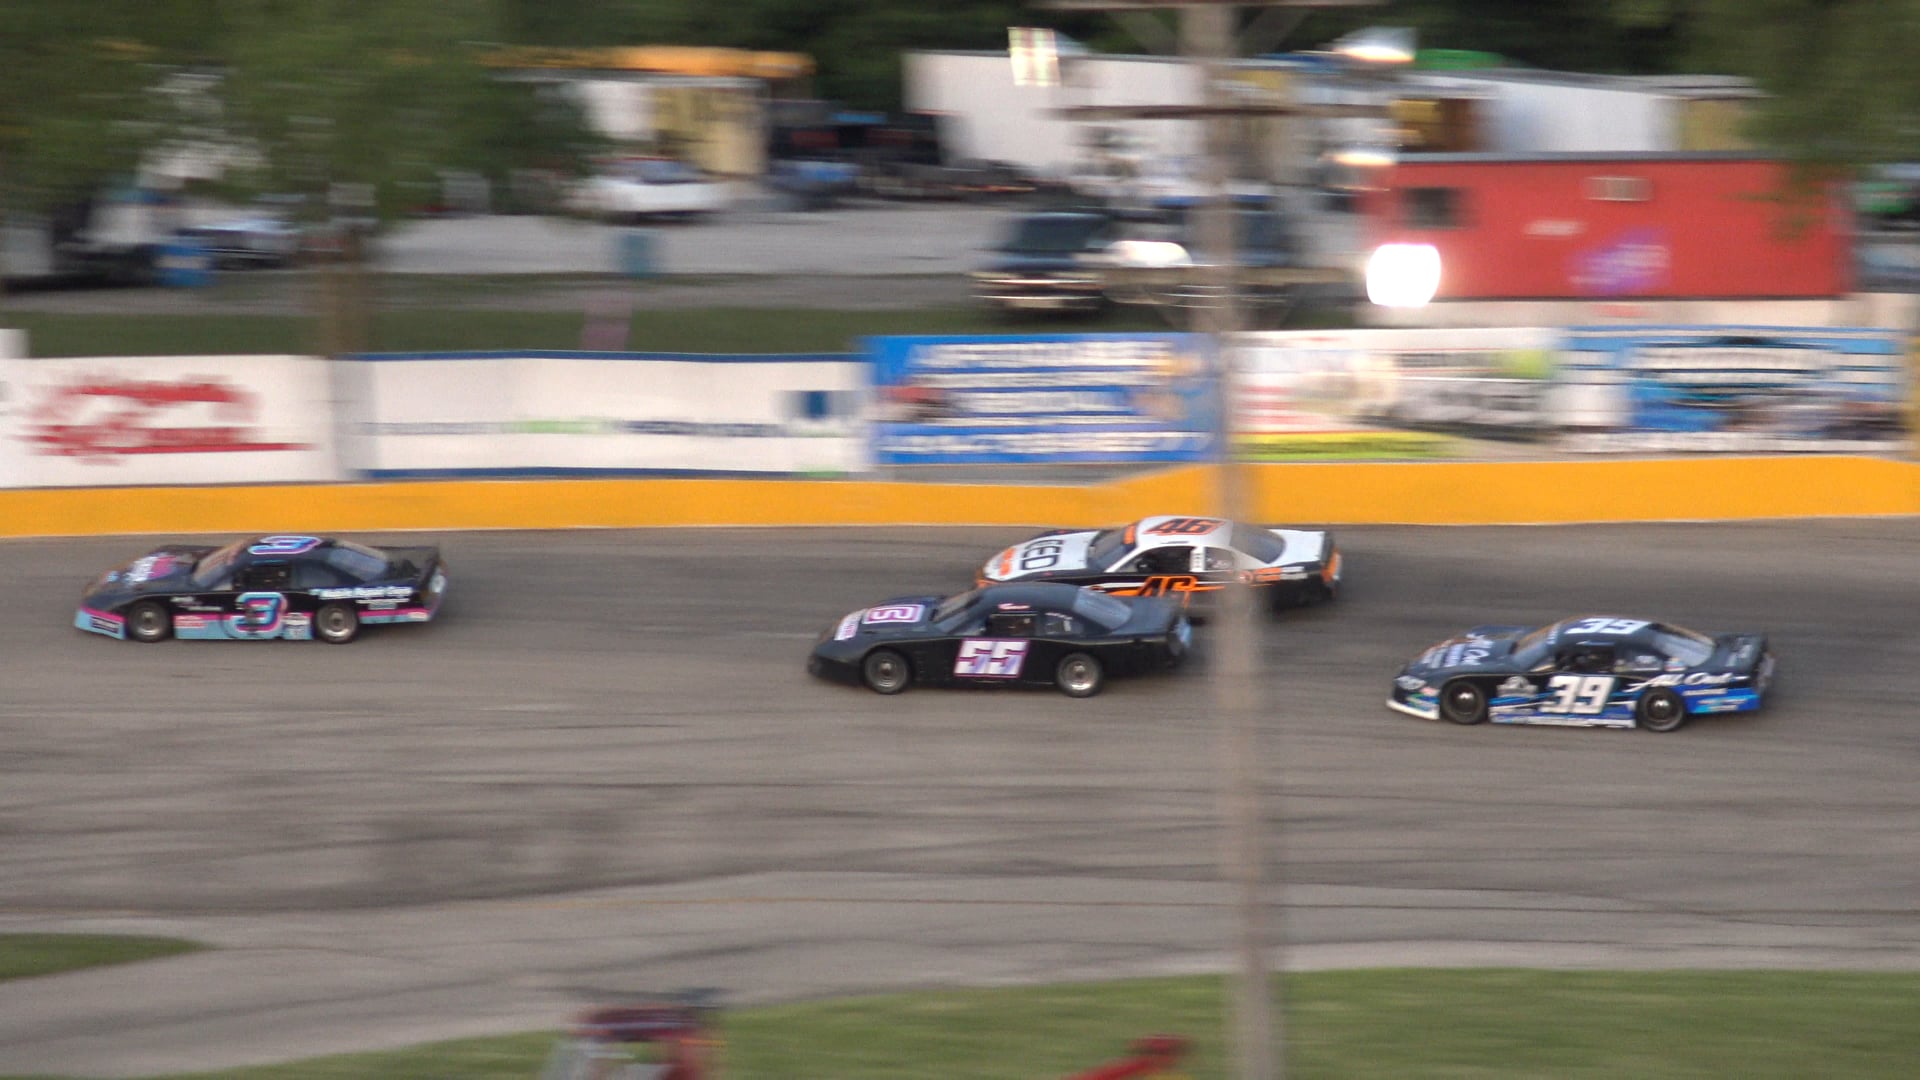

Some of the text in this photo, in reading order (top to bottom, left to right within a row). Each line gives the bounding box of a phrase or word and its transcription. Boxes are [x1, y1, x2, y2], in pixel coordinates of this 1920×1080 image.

[1143, 517, 1224, 535] 46
[248, 535, 322, 555] 3
[231, 592, 288, 635] 3
[1565, 617, 1650, 635] 39
[954, 640, 1028, 675] 55
[1538, 675, 1616, 714] 39
